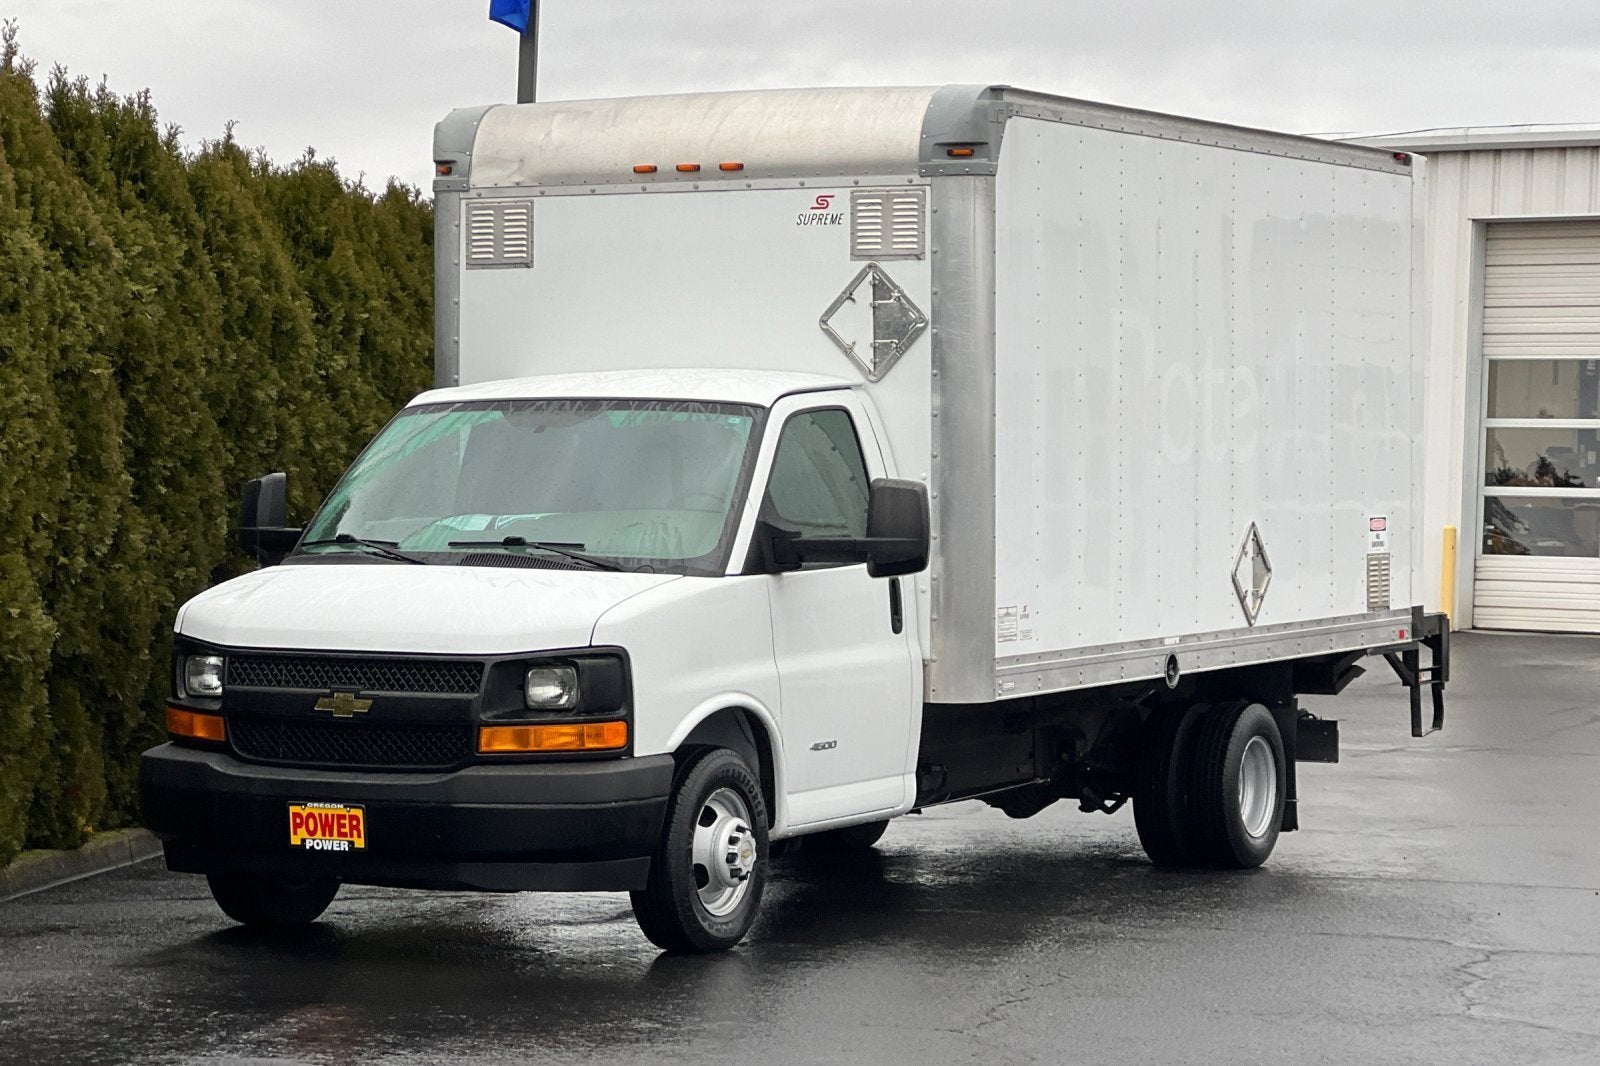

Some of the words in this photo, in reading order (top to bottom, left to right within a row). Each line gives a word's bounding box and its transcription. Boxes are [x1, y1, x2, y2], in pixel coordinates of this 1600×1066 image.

[796, 213, 844, 226] SUPREME
[306, 802, 345, 810] OREGON
[291, 811, 362, 839] POWER
[305, 838, 349, 851] POWER
